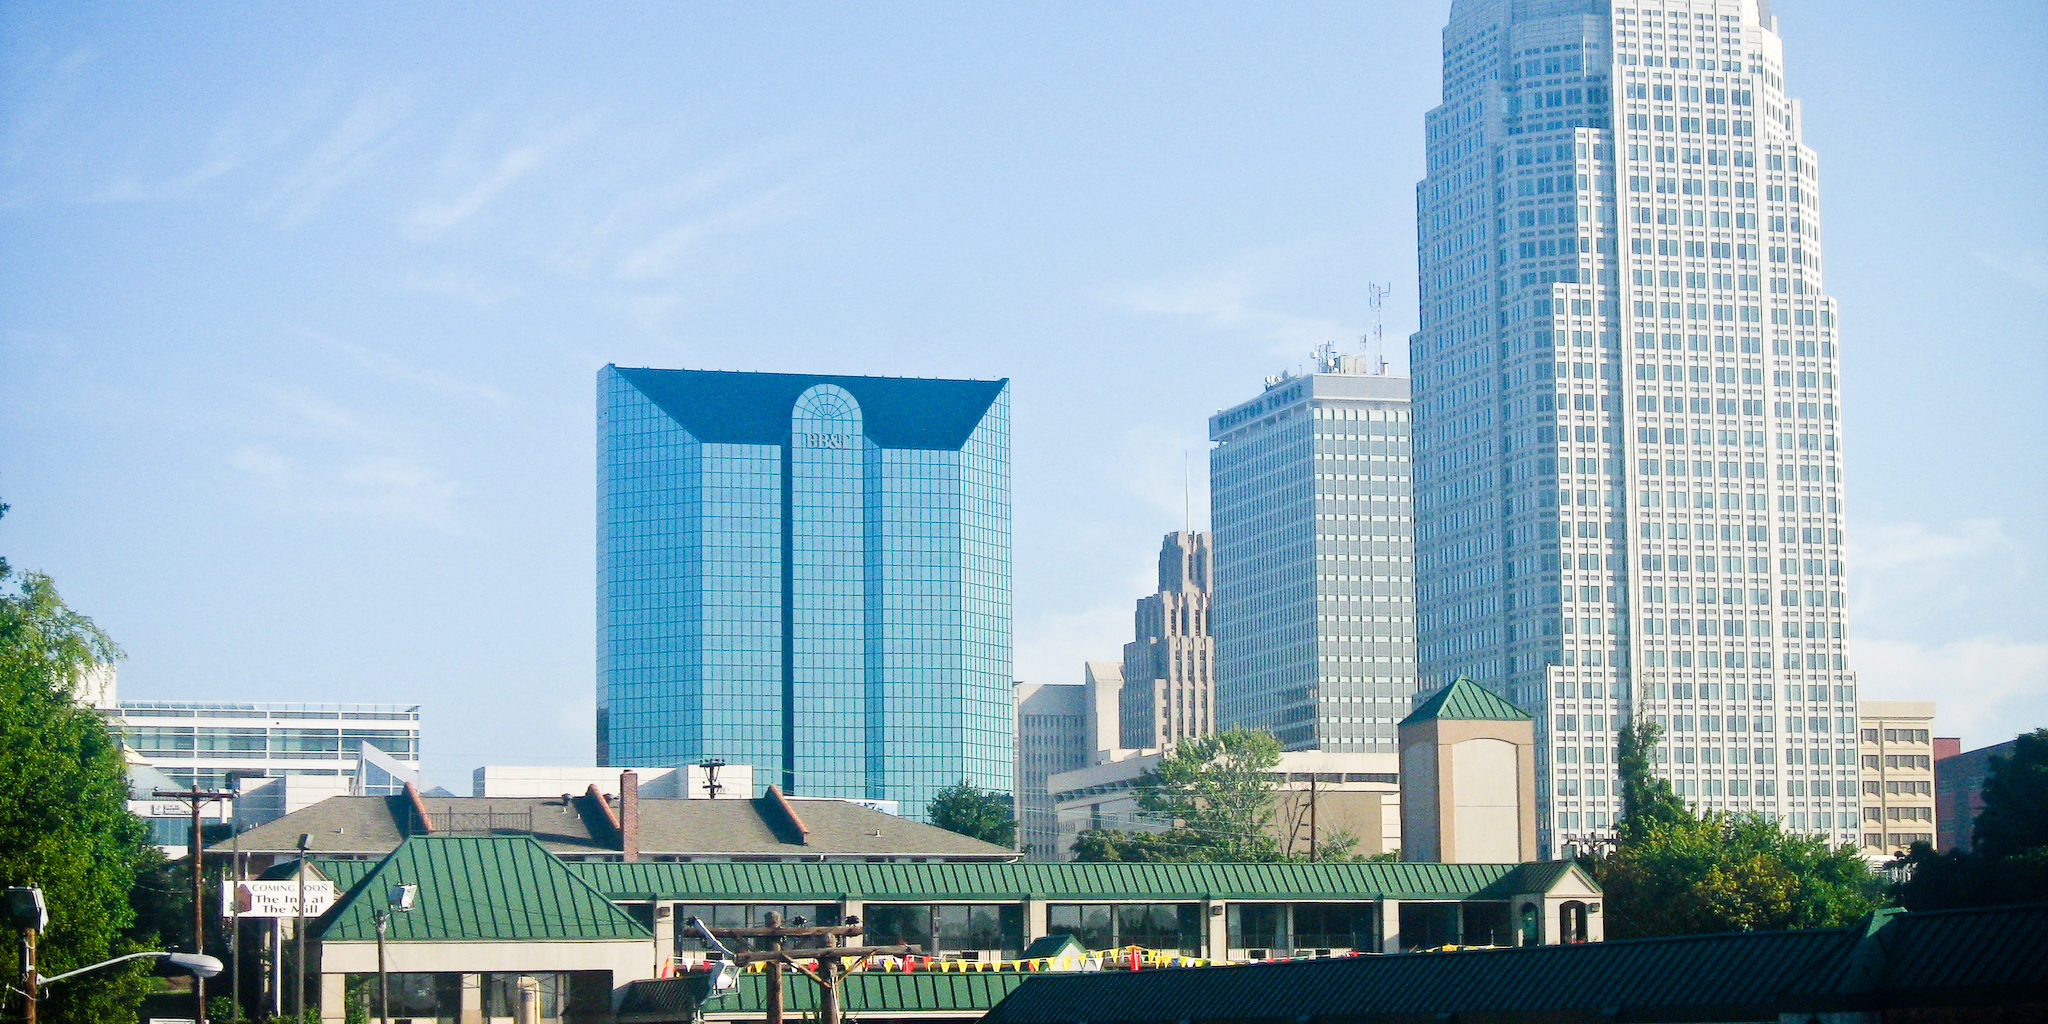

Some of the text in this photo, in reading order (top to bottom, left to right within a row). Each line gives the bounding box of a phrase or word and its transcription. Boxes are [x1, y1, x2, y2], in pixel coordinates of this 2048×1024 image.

[804, 432, 853, 449] BB&T
[252, 884, 328, 892] COMING OON
[255, 894, 324, 904] The In at
[263, 904, 286, 914] The
